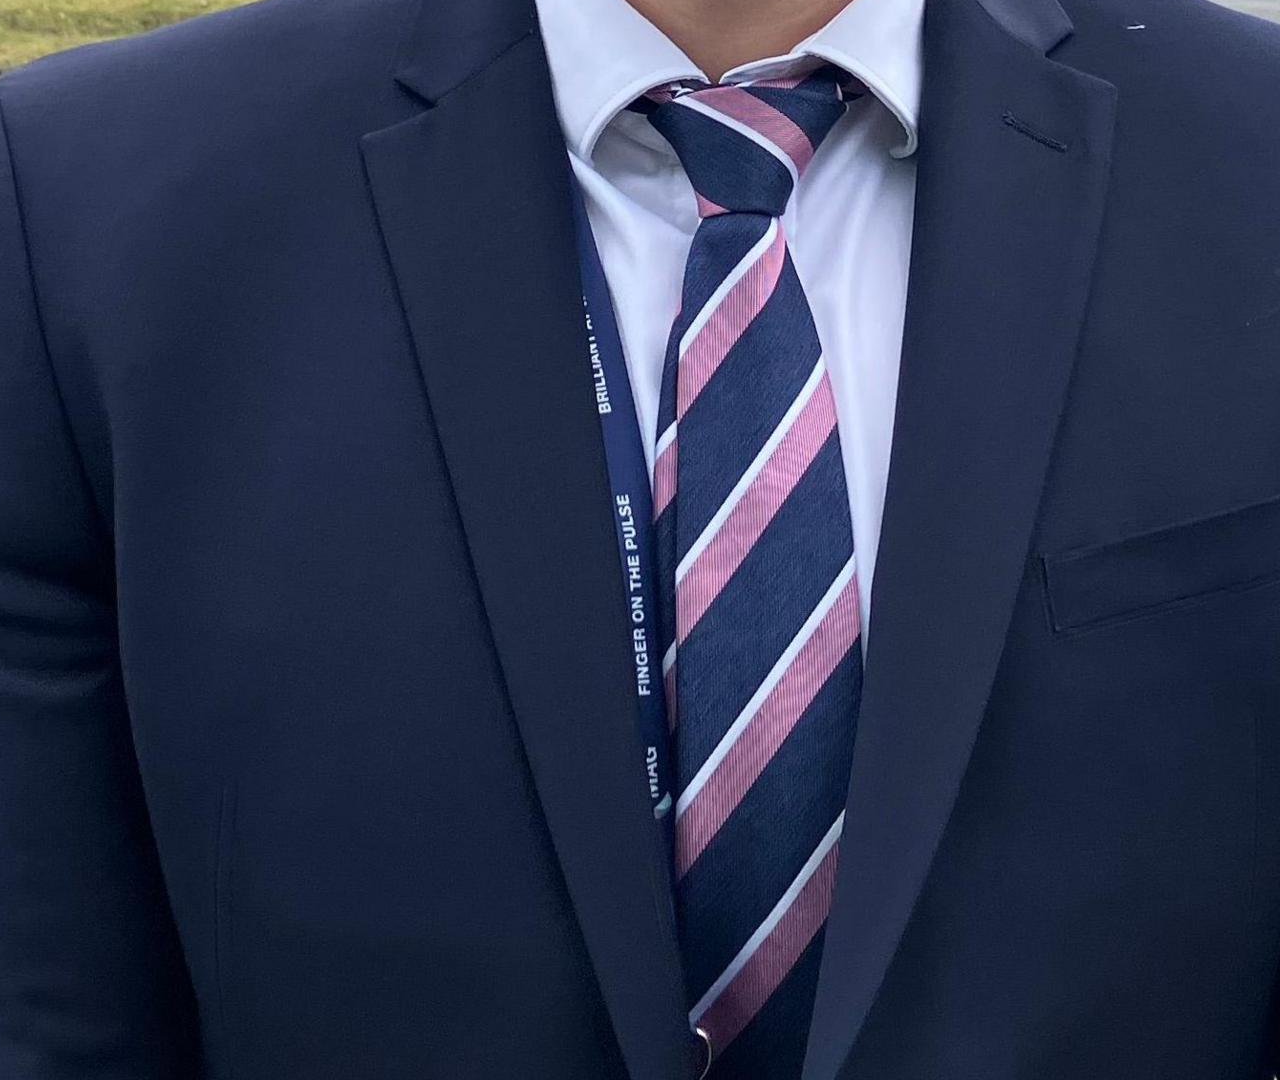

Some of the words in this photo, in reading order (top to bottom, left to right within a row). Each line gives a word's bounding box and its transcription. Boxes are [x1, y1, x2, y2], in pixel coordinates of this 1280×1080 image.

[616, 493, 638, 551] PULSE
[627, 554, 641, 593] THE
[631, 596, 645, 624] ON
[633, 627, 651, 697] FINGER
[646, 746, 660, 799] MAG
